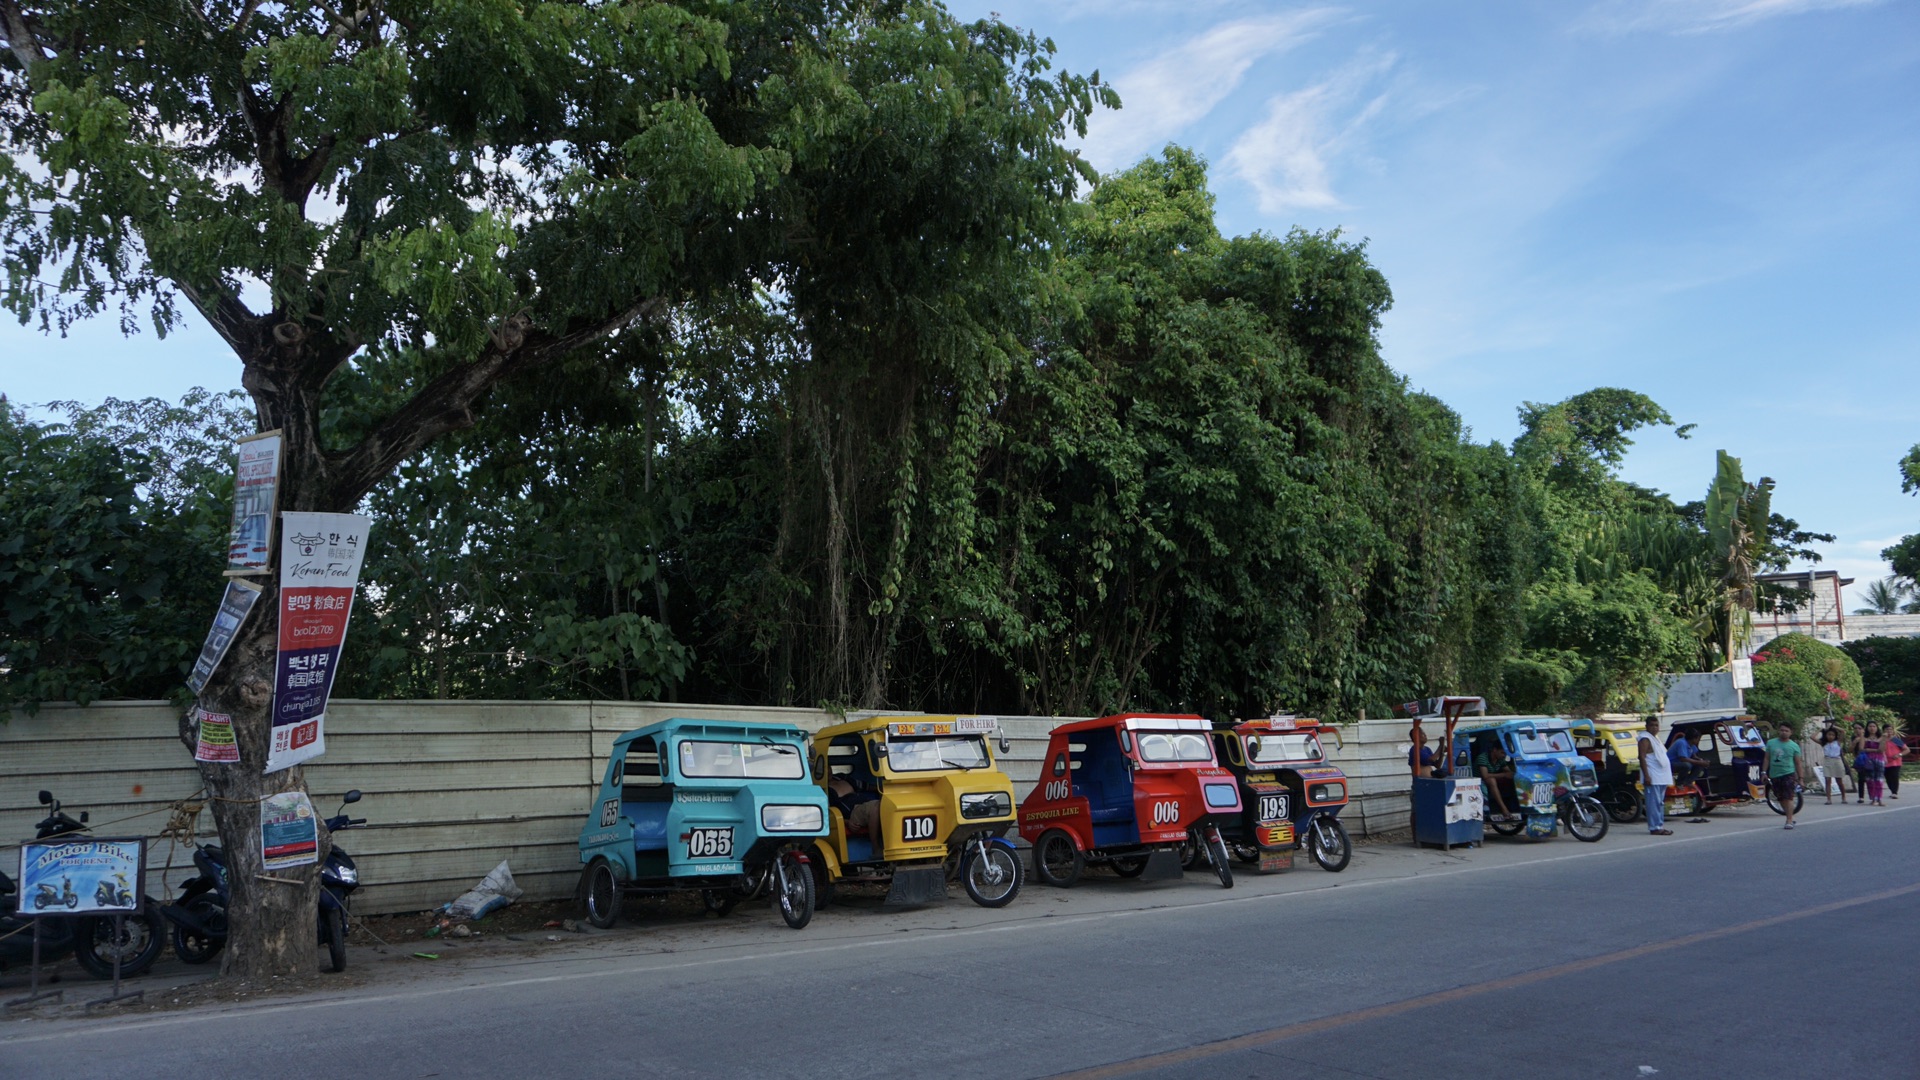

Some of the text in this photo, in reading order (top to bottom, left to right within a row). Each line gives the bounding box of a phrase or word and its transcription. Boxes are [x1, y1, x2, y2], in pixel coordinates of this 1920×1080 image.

[897, 724, 915, 734] EM
[933, 724, 950, 734] EM
[960, 718, 995, 729] FOR HIRE
[1045, 780, 1068, 801] 006
[602, 801, 618, 826] 055
[1026, 807, 1079, 820] ESTOQUIA LINE
[1154, 801, 1179, 823] 006
[1262, 797, 1287, 820] 193
[904, 817, 934, 839] 110
[690, 829, 731, 856] 055
[40, 843, 133, 866] Motor Bike
[60, 857, 80, 865] FOR
